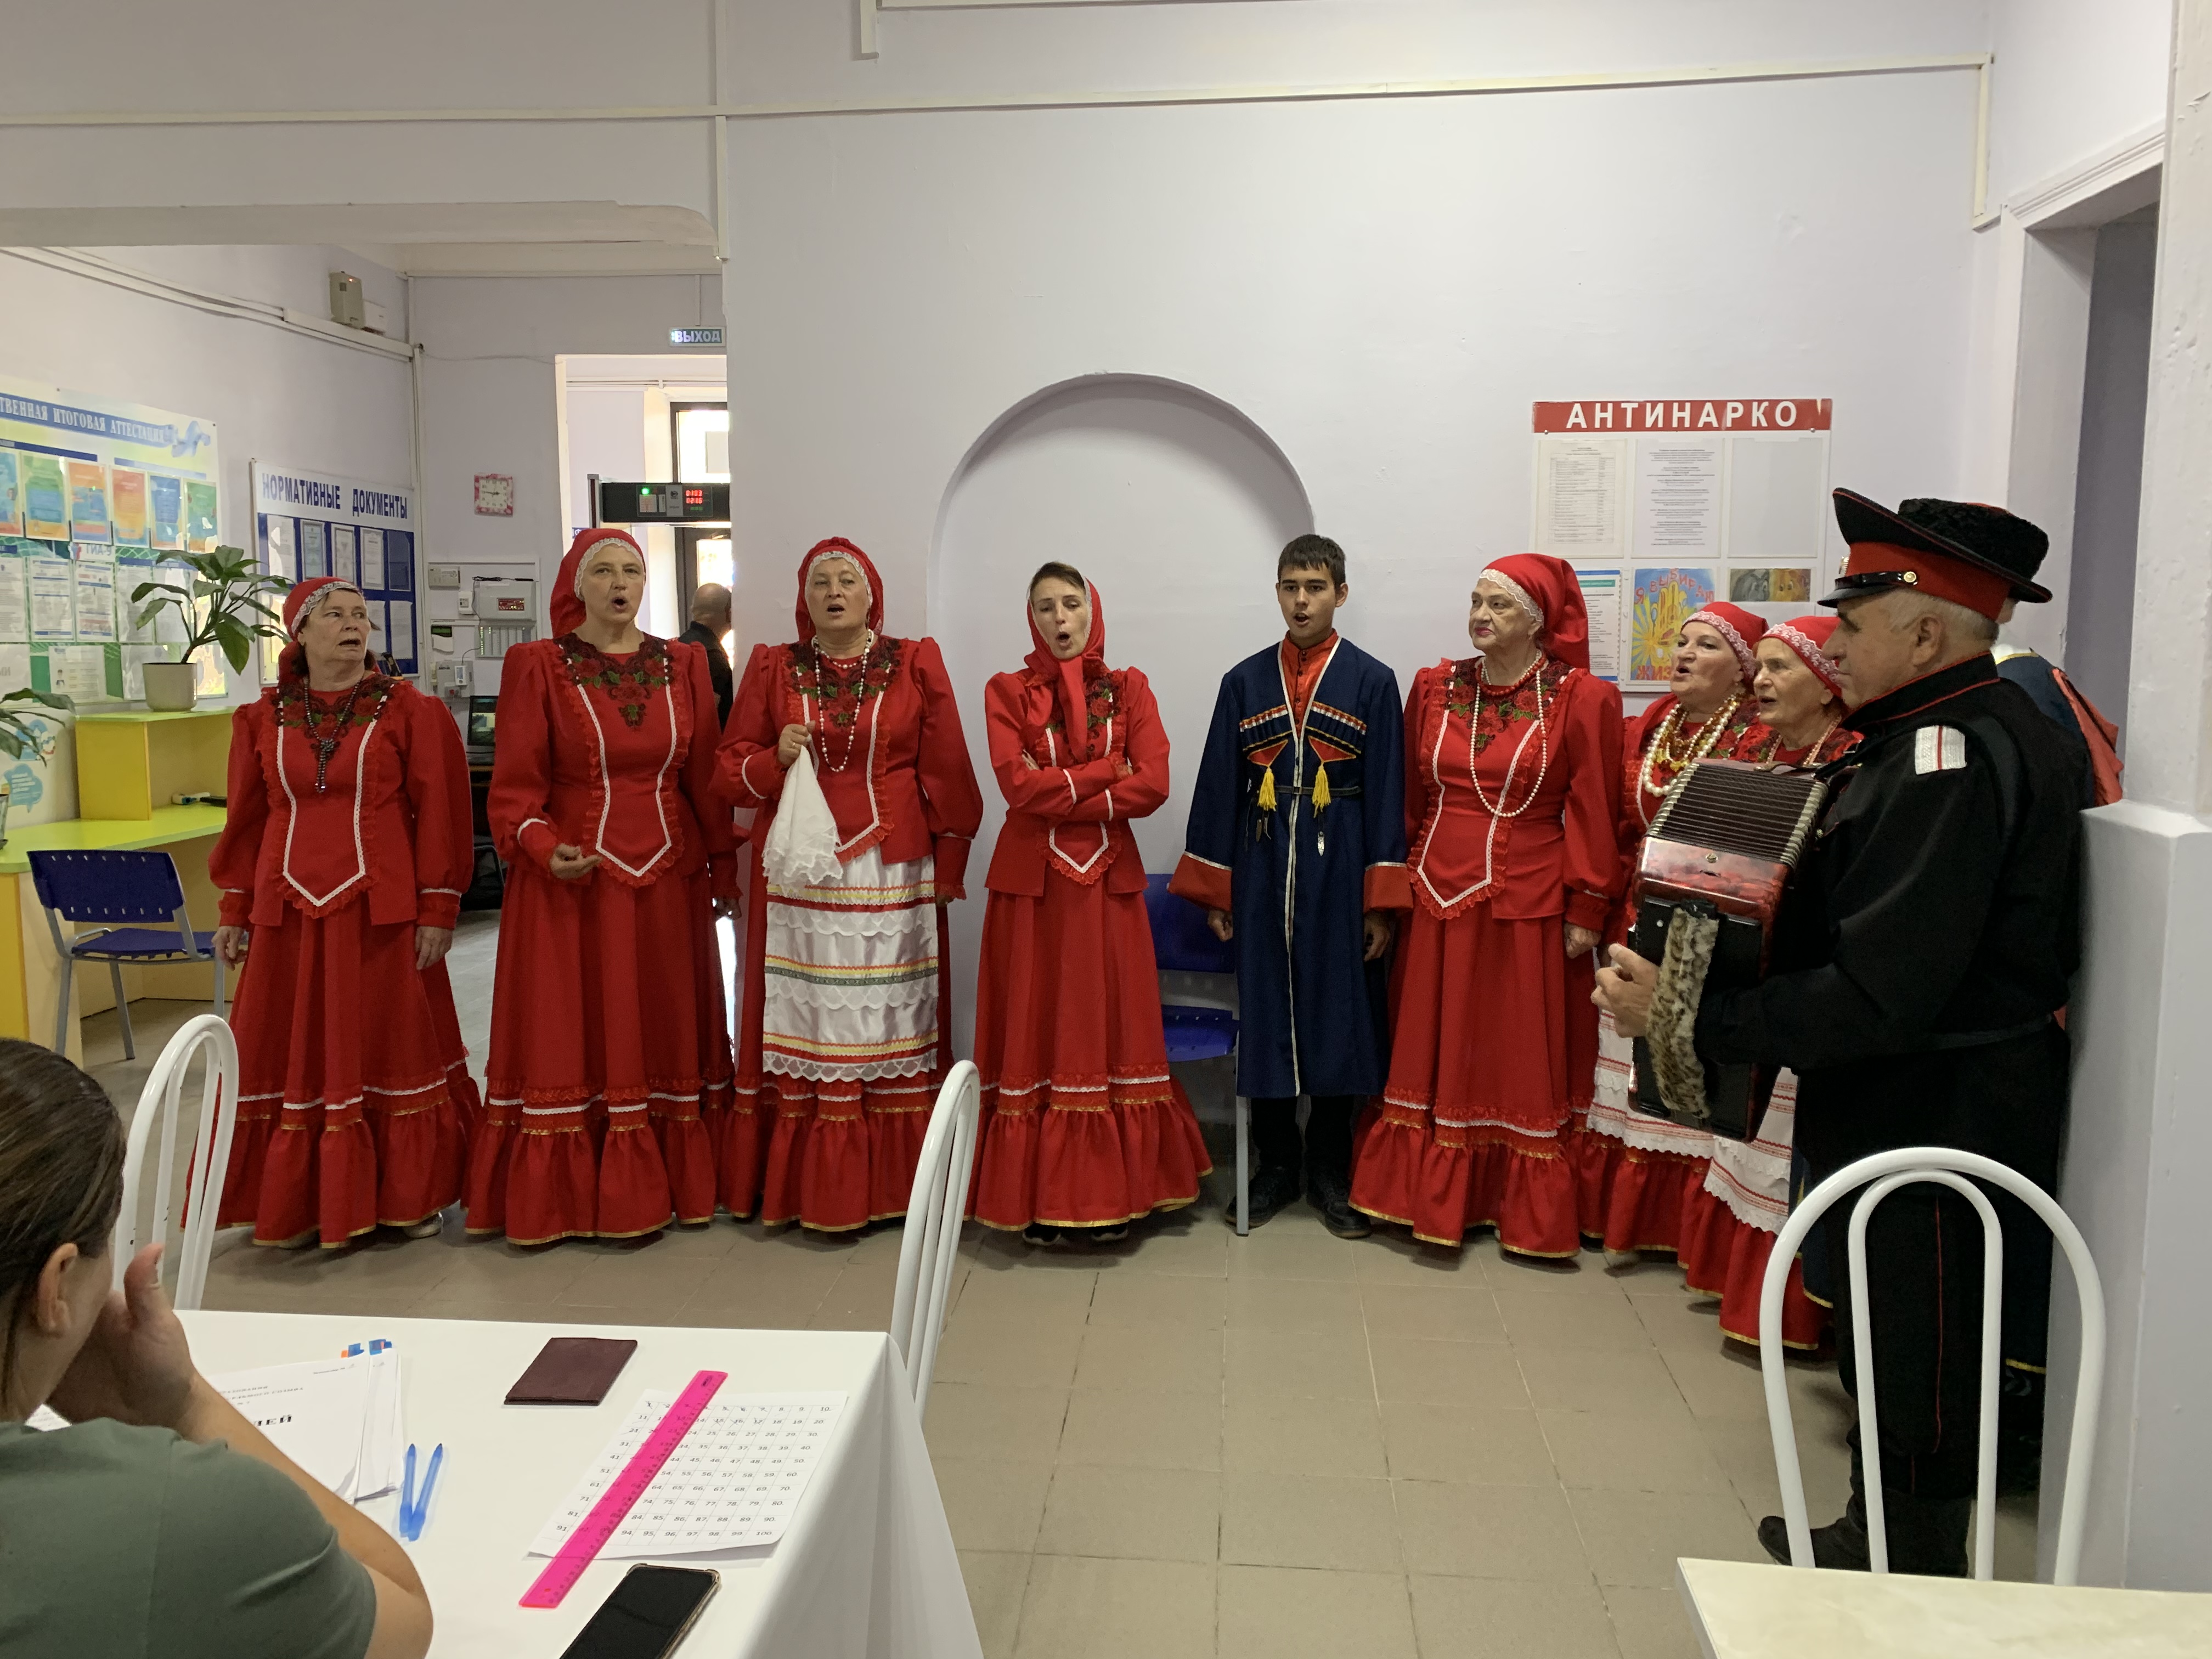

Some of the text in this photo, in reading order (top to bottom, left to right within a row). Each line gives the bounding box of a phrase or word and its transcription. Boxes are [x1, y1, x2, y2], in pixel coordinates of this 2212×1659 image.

[674, 330, 720, 342] ВЫХОД
[53, 408, 105, 432] ИТОГОВАЯ
[110, 420, 164, 443] АТТЕСТАЦИЯ
[1566, 401, 1797, 428] АНТИНАРКО
[262, 473, 407, 519] НОРМАТИВНЫЕ ДОКУМЕНТЫ
[86, 543, 112, 556] ГИА-9
[1634, 568, 1714, 604] Я ВЫБИРАЮ
